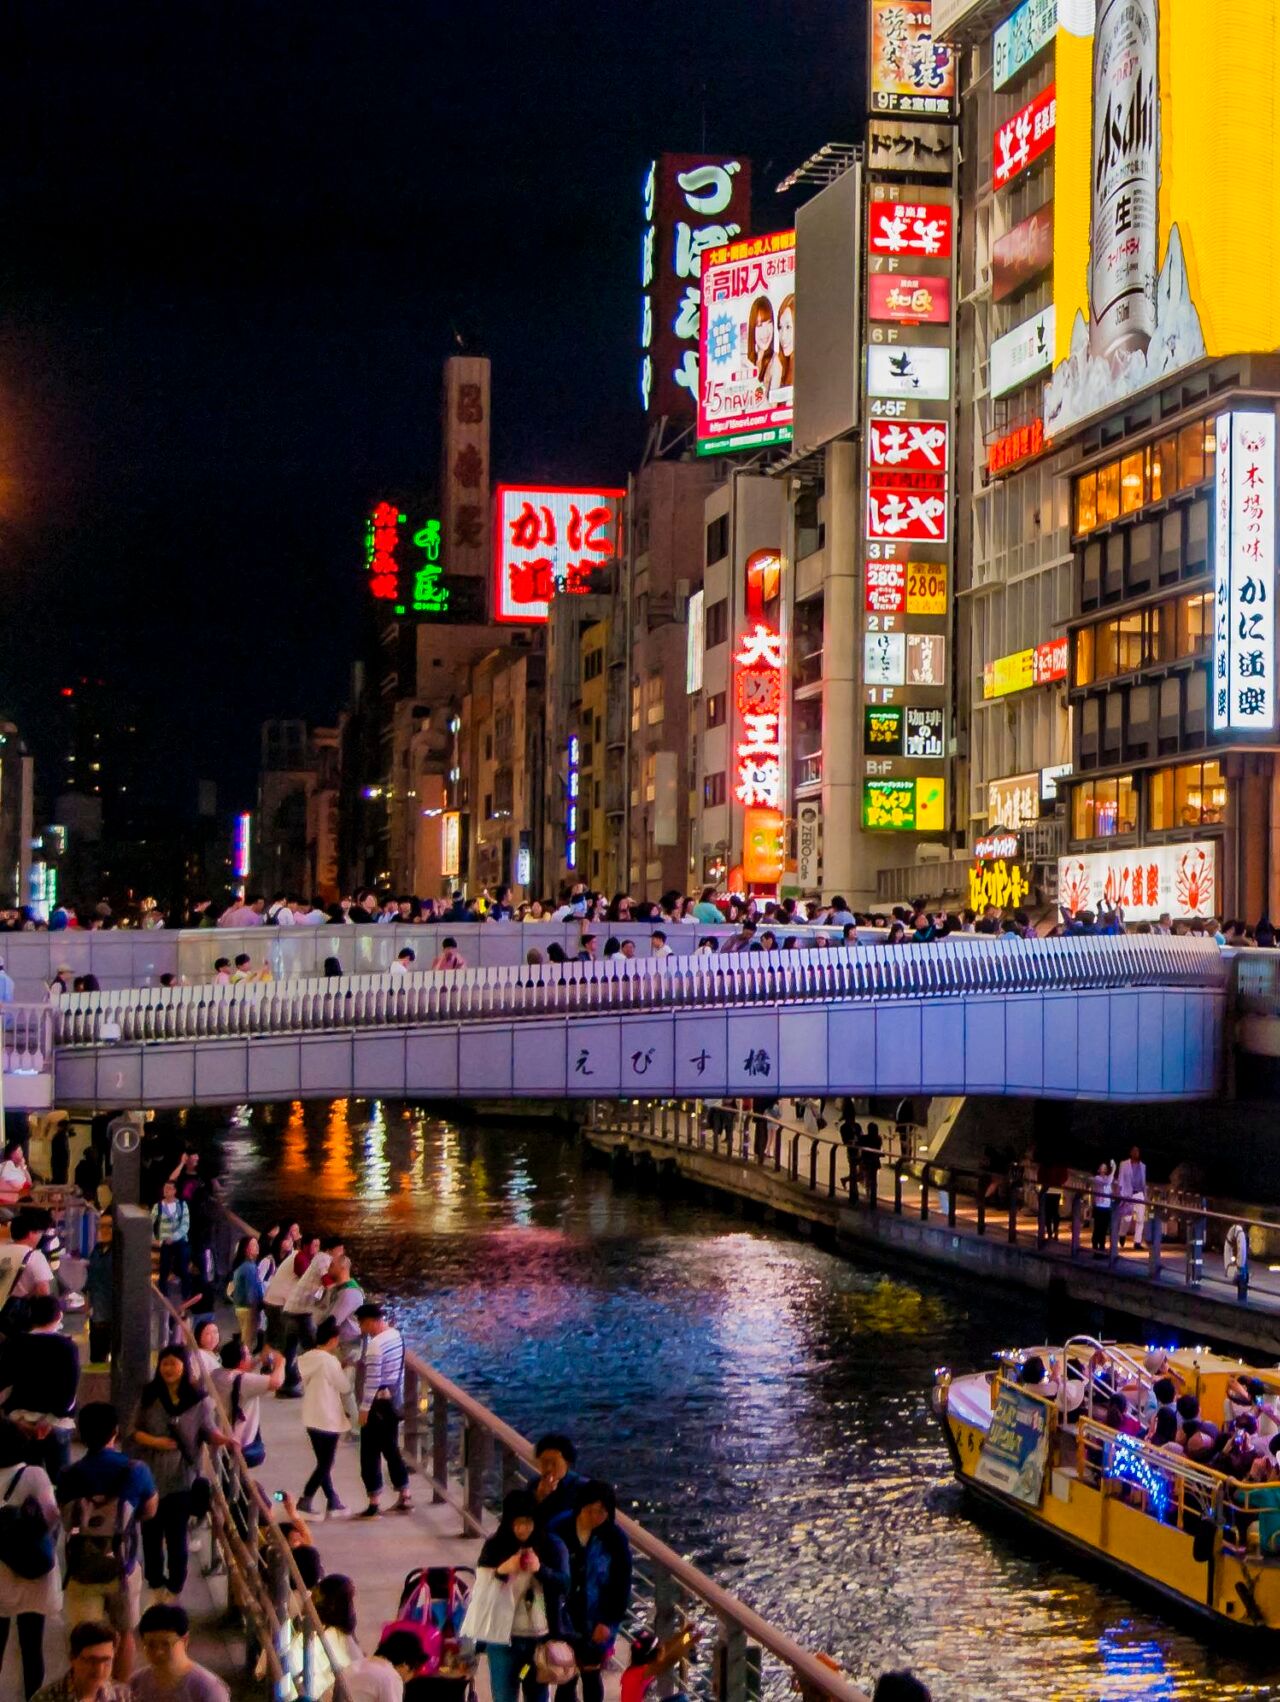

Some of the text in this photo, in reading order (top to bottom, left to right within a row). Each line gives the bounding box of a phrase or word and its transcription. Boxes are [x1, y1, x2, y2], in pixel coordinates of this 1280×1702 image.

[877, 91, 898, 110] 9F
[1096, 68, 1154, 193] Asahi
[1115, 194, 1132, 236] 生
[874, 257, 899, 272] 7F
[712, 263, 768, 303] 高収入
[872, 328, 898, 343] 6F
[871, 425, 945, 465] はや
[871, 494, 945, 535] はや
[1242, 461, 1265, 562] 本場の味
[510, 502, 613, 552] かに
[869, 543, 896, 559] 3F
[908, 575, 946, 597] 280円
[868, 616, 895, 631] 2F
[1237, 575, 1266, 716] かに道楽
[868, 688, 894, 703] 1F
[919, 725, 931, 738] の
[908, 736, 942, 755] 青山
[575, 1048, 771, 1077] えびす橋
